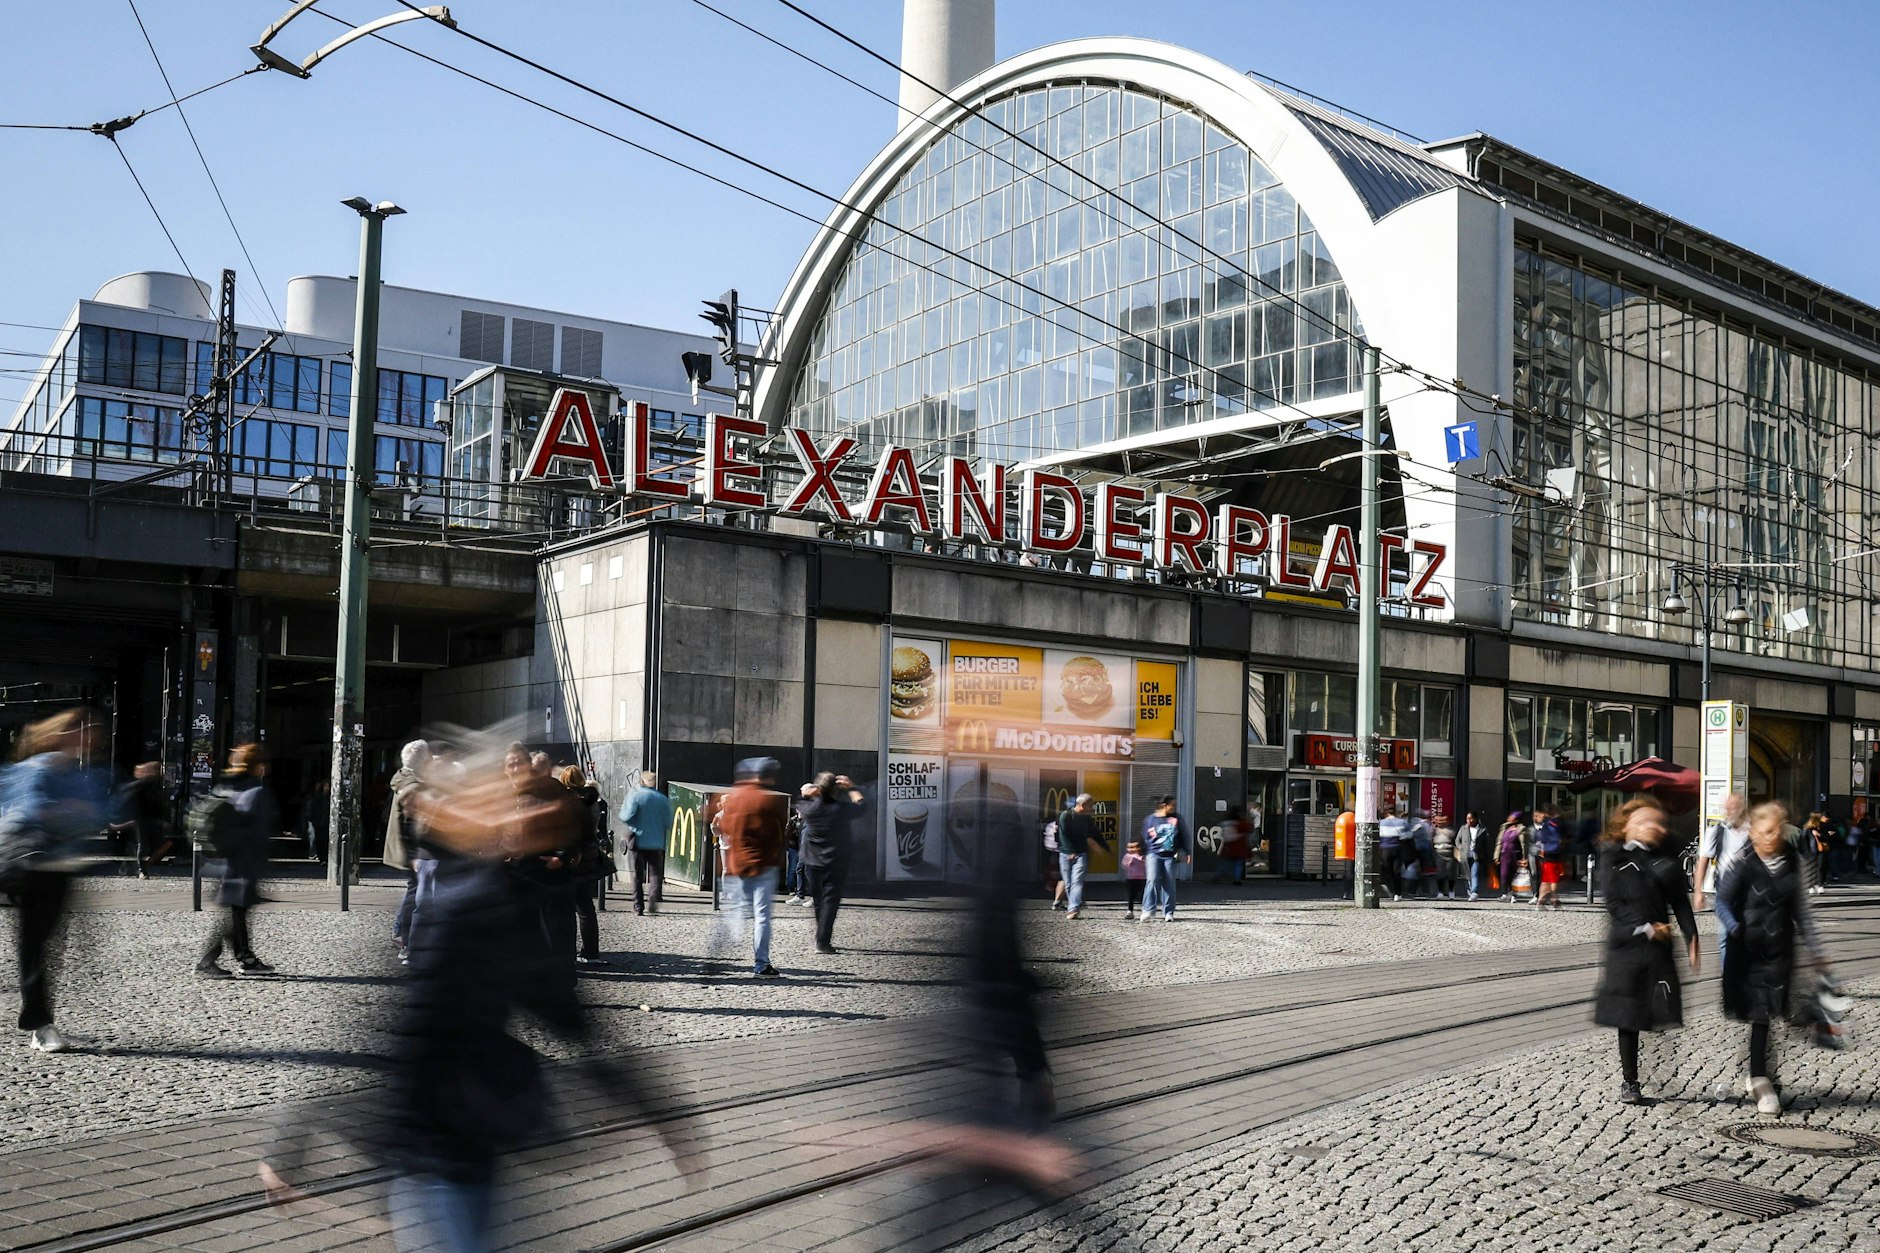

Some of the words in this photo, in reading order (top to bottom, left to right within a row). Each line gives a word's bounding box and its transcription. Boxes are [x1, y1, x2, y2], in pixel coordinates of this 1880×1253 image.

[519, 387, 1447, 609] ALEXANDERPLATZ
[954, 656, 1019, 674] BURGER
[954, 673, 983, 690] FÜR
[985, 675, 1038, 691] MITTE?
[1140, 681, 1159, 694] ICH
[954, 690, 1002, 706] BITTE!
[1140, 694, 1172, 706] LIEBE
[1140, 707, 1159, 720] ES!
[994, 727, 1133, 756] McDonald's
[888, 762, 941, 774] SCHLAF-
[889, 774, 912, 786] LOS
[914, 774, 927, 786] IN
